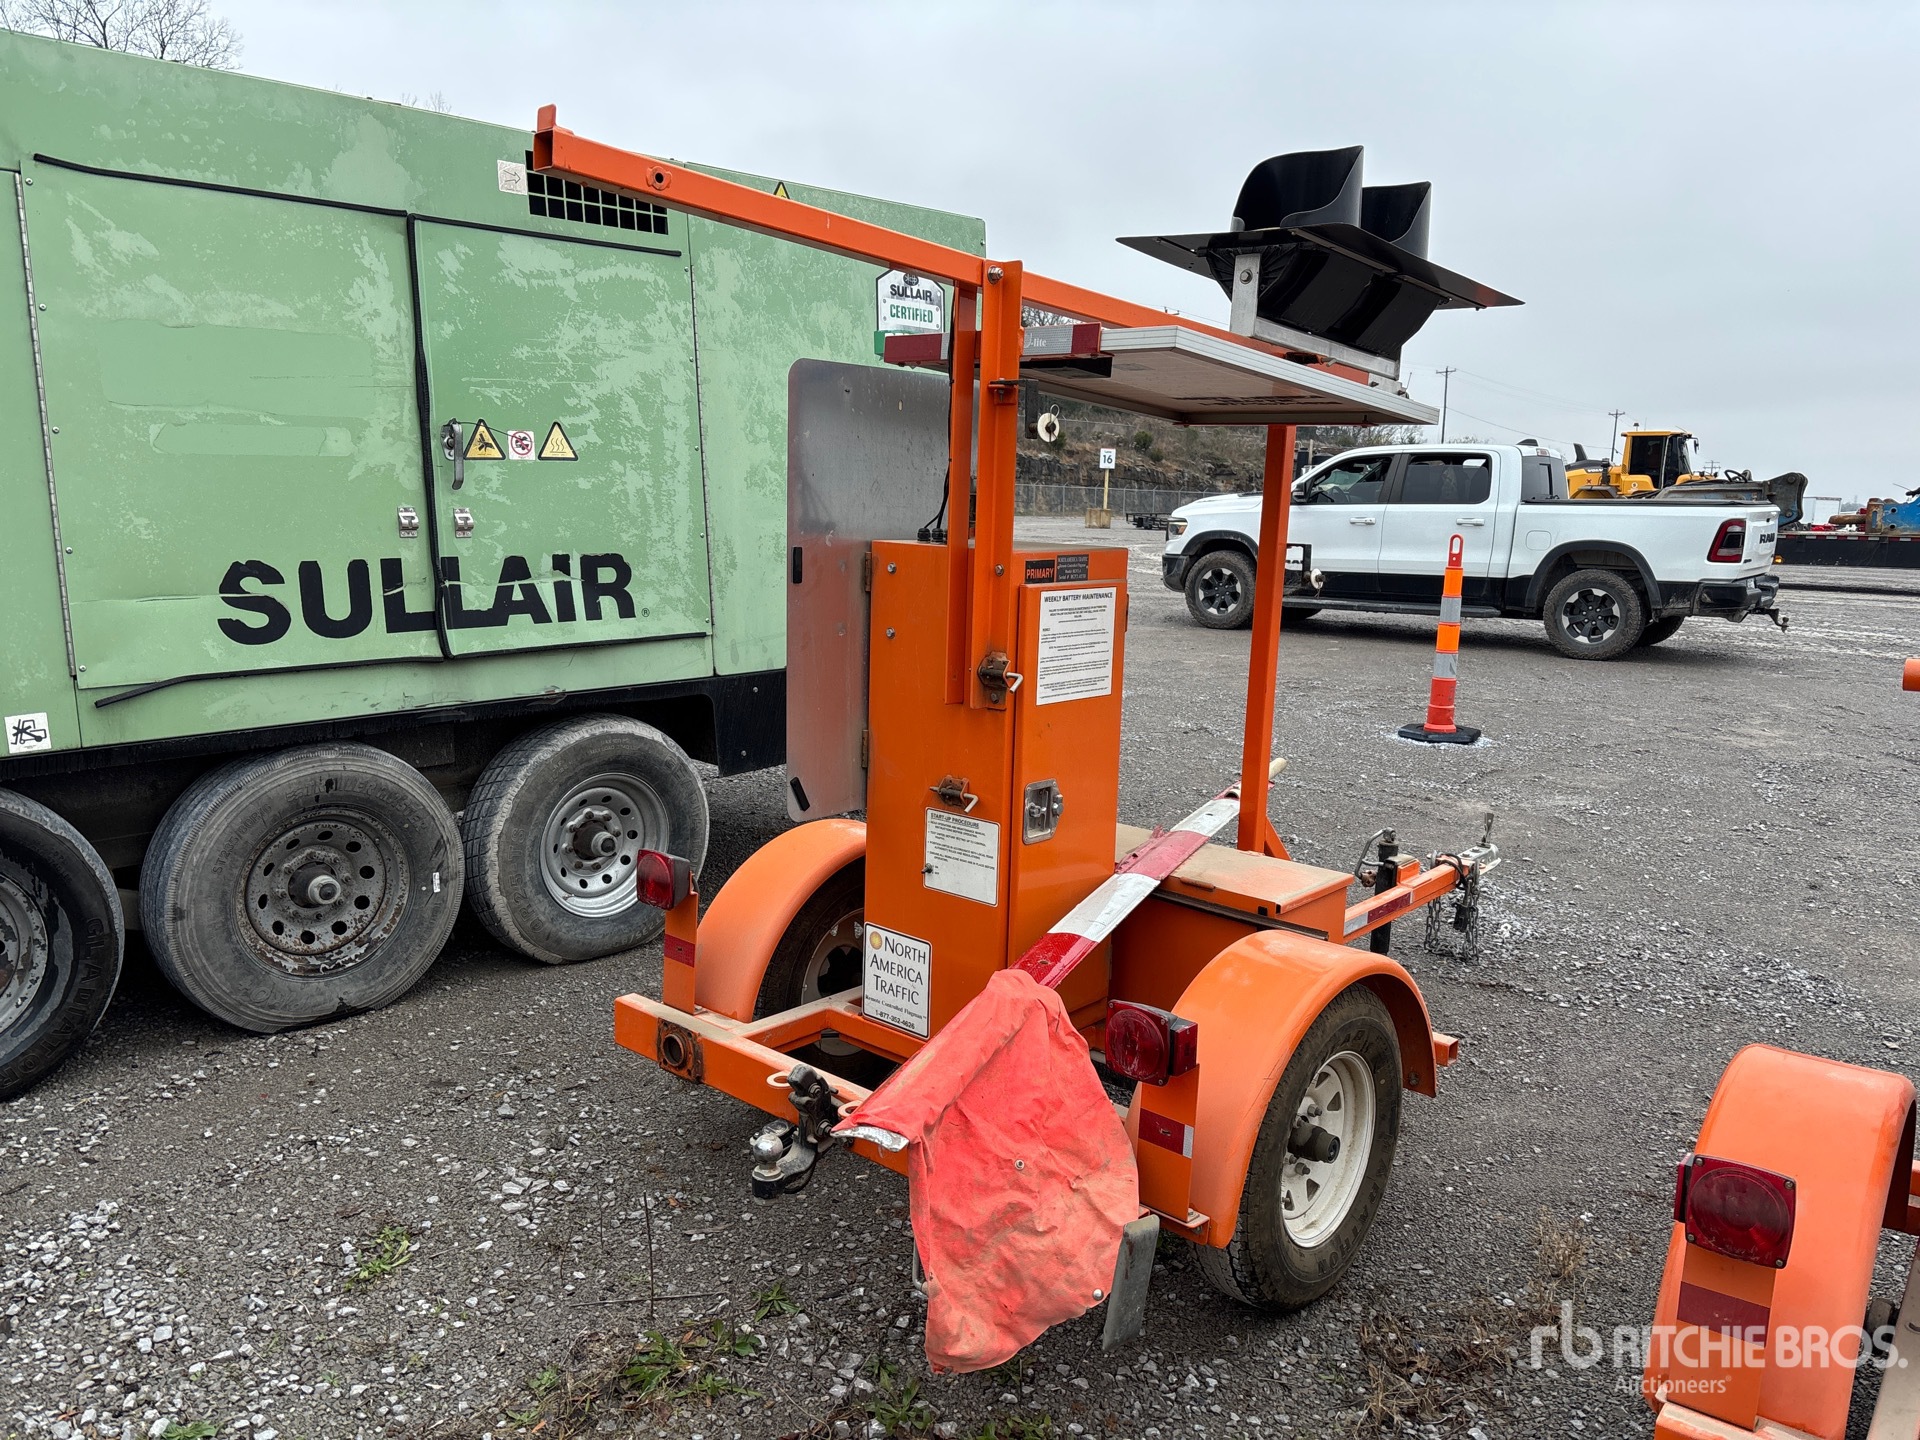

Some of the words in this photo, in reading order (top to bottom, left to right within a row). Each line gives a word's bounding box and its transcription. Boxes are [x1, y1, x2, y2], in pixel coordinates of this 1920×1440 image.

[890, 284, 932, 302] SULLAIR
[890, 304, 933, 323] CERTIFIED
[1103, 455, 1113, 464] 16
[1026, 568, 1054, 580] PRIMARY
[217, 552, 637, 645] SULLAIR
[1044, 595, 1062, 603] WEEKLY
[1082, 591, 1113, 600] MAINTENANCE
[931, 812, 952, 822] START-UP
[952, 817, 979, 828] PROCEDURE
[884, 935, 926, 965] NORTH
[870, 953, 923, 985] AMERICA
[873, 974, 920, 1005] TRAFFIC
[865, 993, 881, 1005] Remote
[881, 1000, 904, 1013] Controlled
